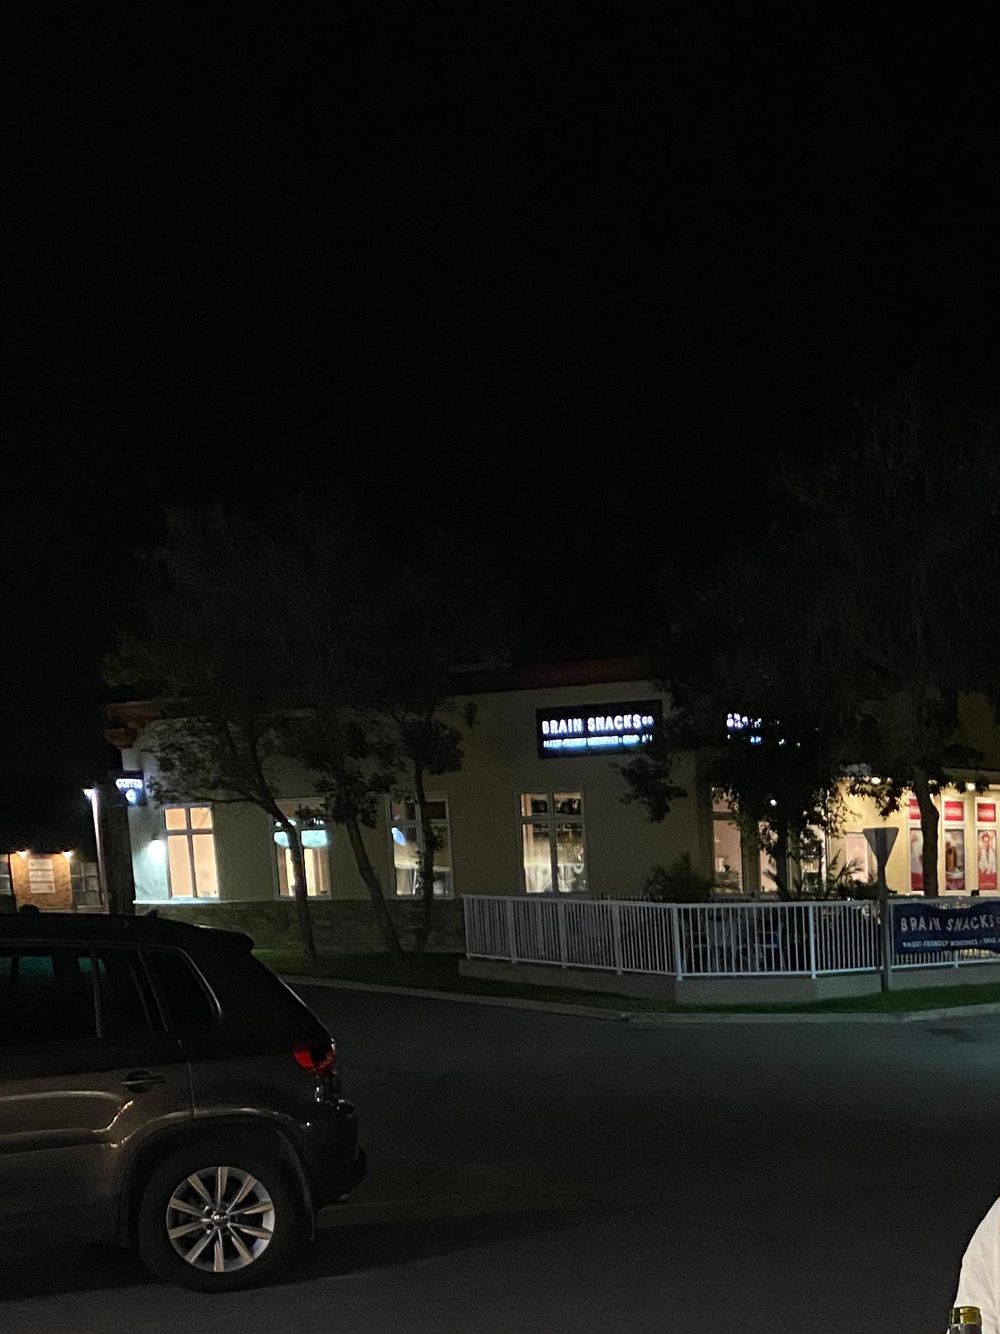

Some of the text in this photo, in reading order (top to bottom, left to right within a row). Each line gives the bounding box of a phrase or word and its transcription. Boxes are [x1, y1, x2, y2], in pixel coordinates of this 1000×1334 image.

[542, 717, 583, 734] BRAIN
[587, 714, 641, 732] SNACKS
[901, 915, 942, 932] BRAIN
[946, 914, 995, 932] SNACKS
